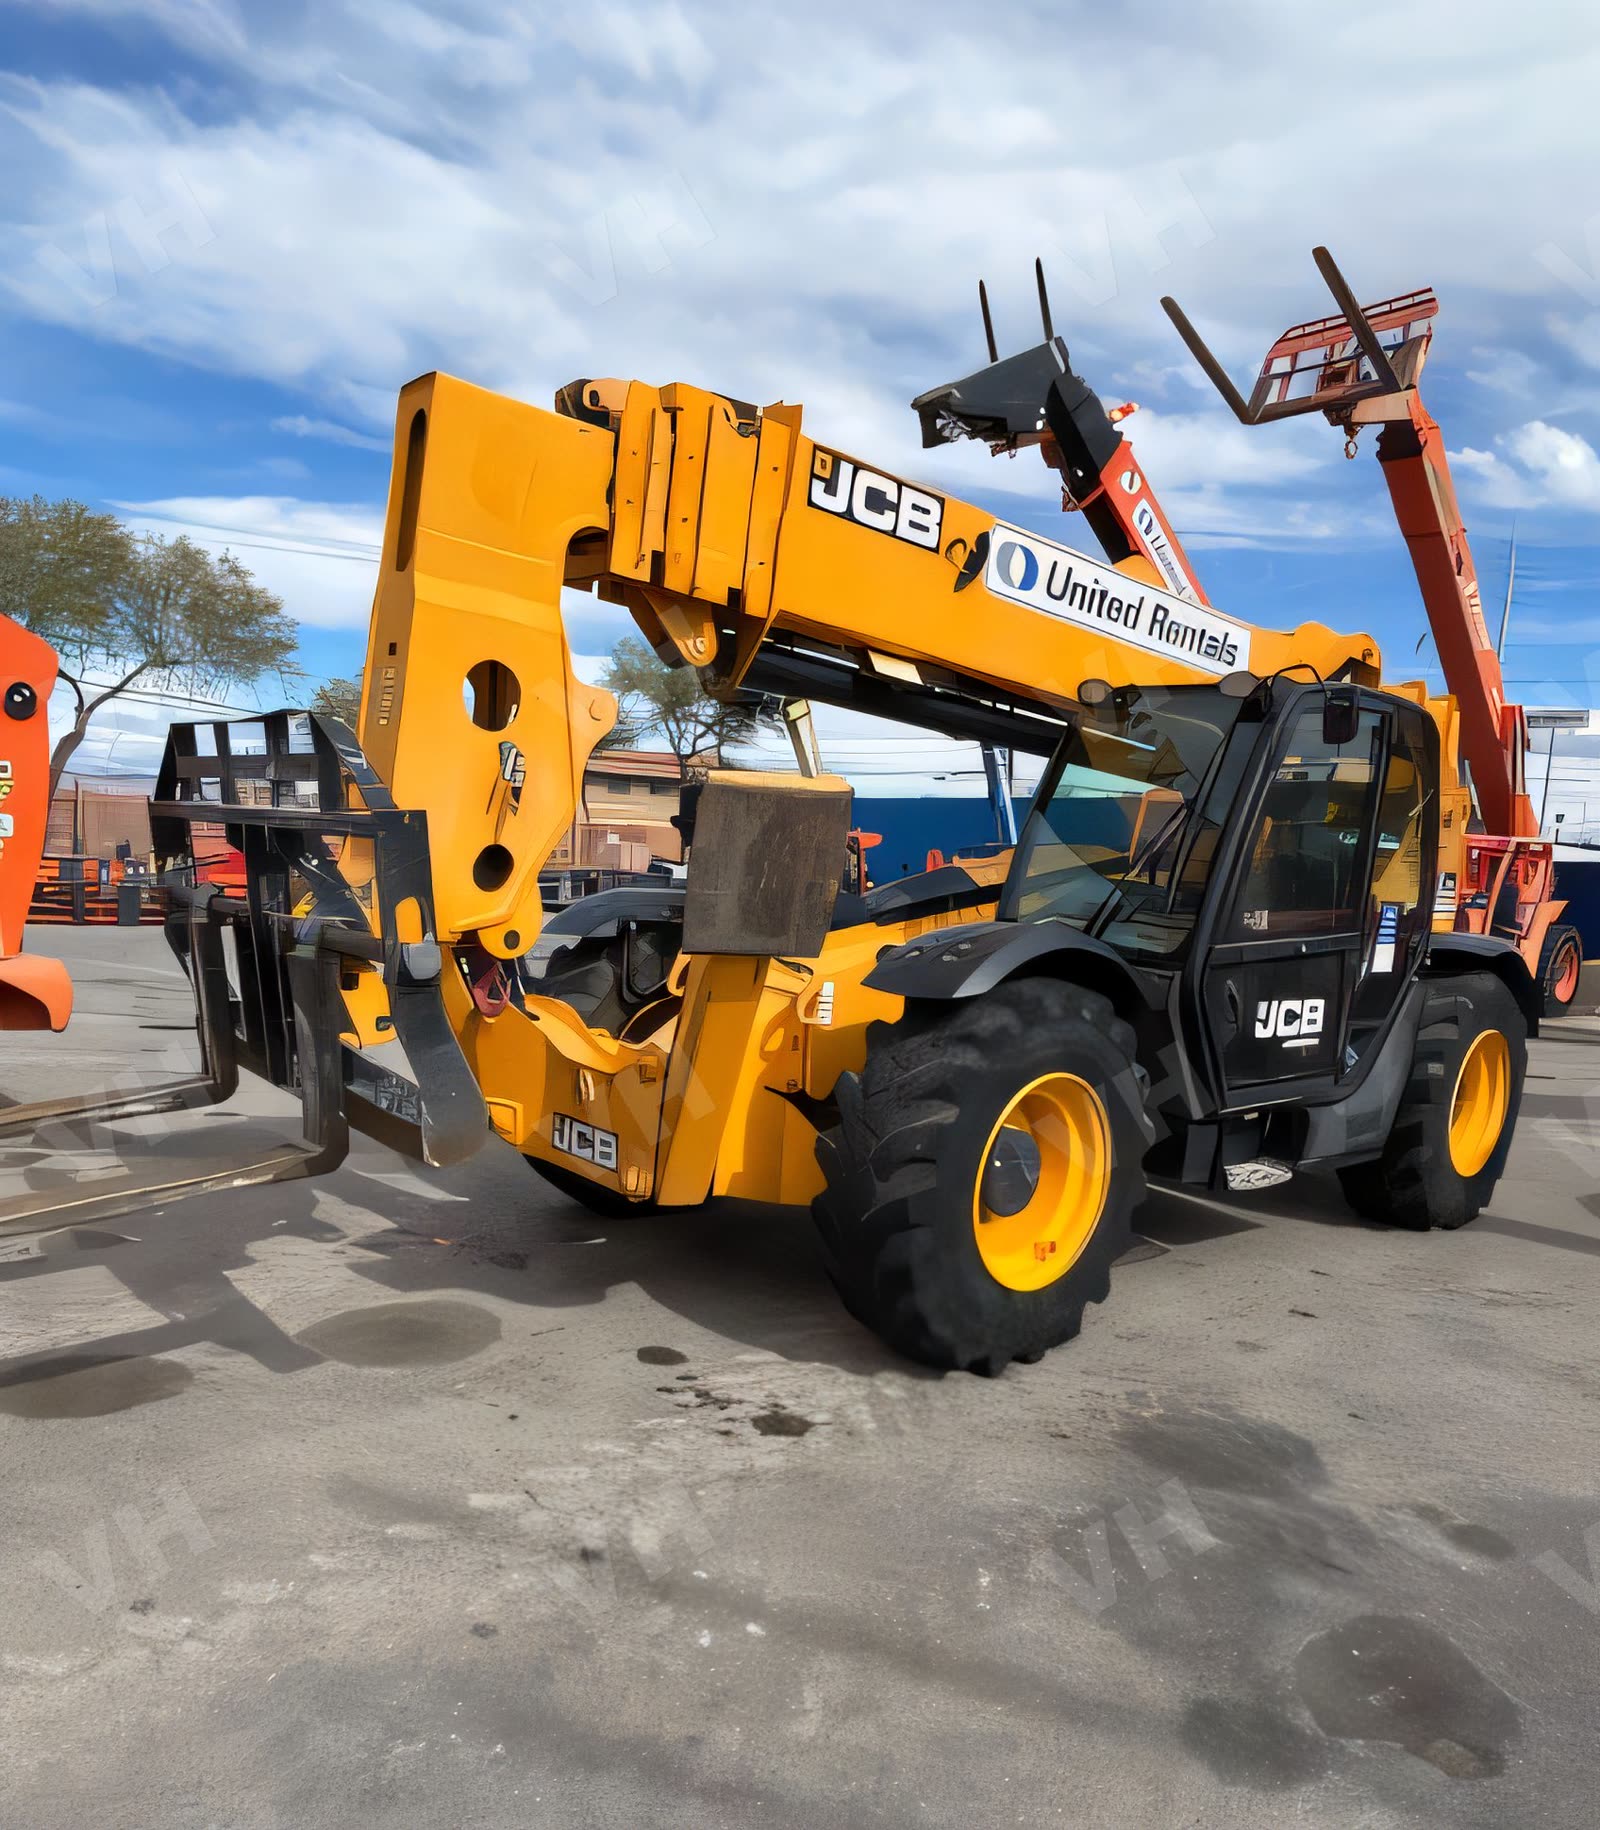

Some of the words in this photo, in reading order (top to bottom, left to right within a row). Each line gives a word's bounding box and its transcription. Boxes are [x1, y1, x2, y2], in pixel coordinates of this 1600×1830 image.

[811, 448, 941, 549] JCB
[1255, 999, 1325, 1038] JCB
[553, 1114, 618, 1172] JCB
